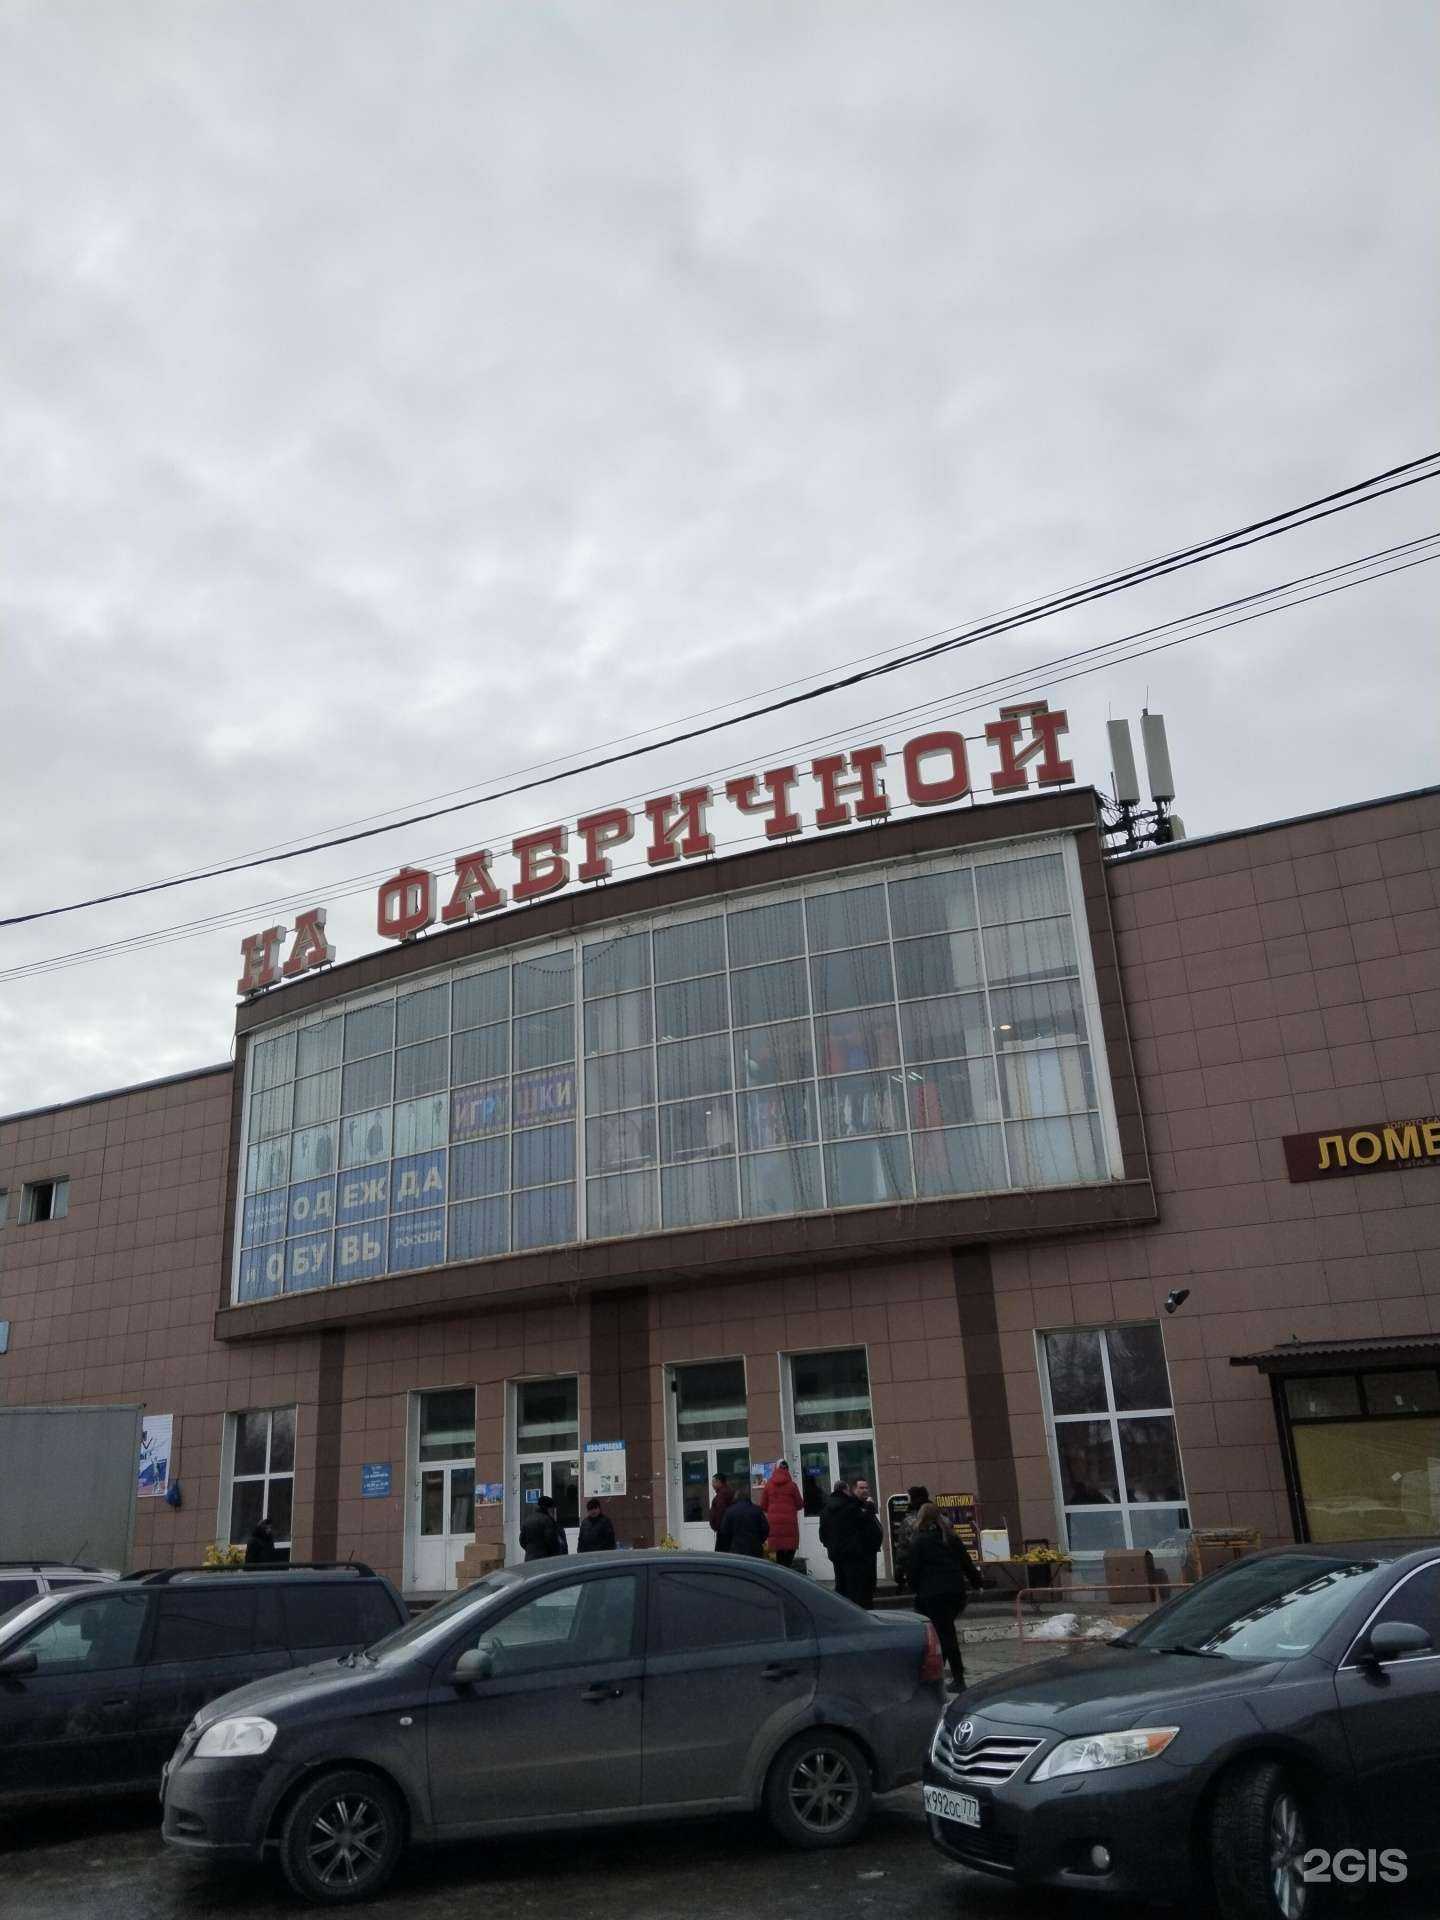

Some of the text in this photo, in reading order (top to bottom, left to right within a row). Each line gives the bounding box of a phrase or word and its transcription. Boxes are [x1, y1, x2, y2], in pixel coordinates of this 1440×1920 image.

[237, 699, 1075, 995] НА ФАБРИЧНОЙ
[455, 1080, 572, 1129] ИГРШКИ
[293, 1166, 443, 1221] ОДЕЖДА
[266, 1232, 381, 1283] ОБУВЬ
